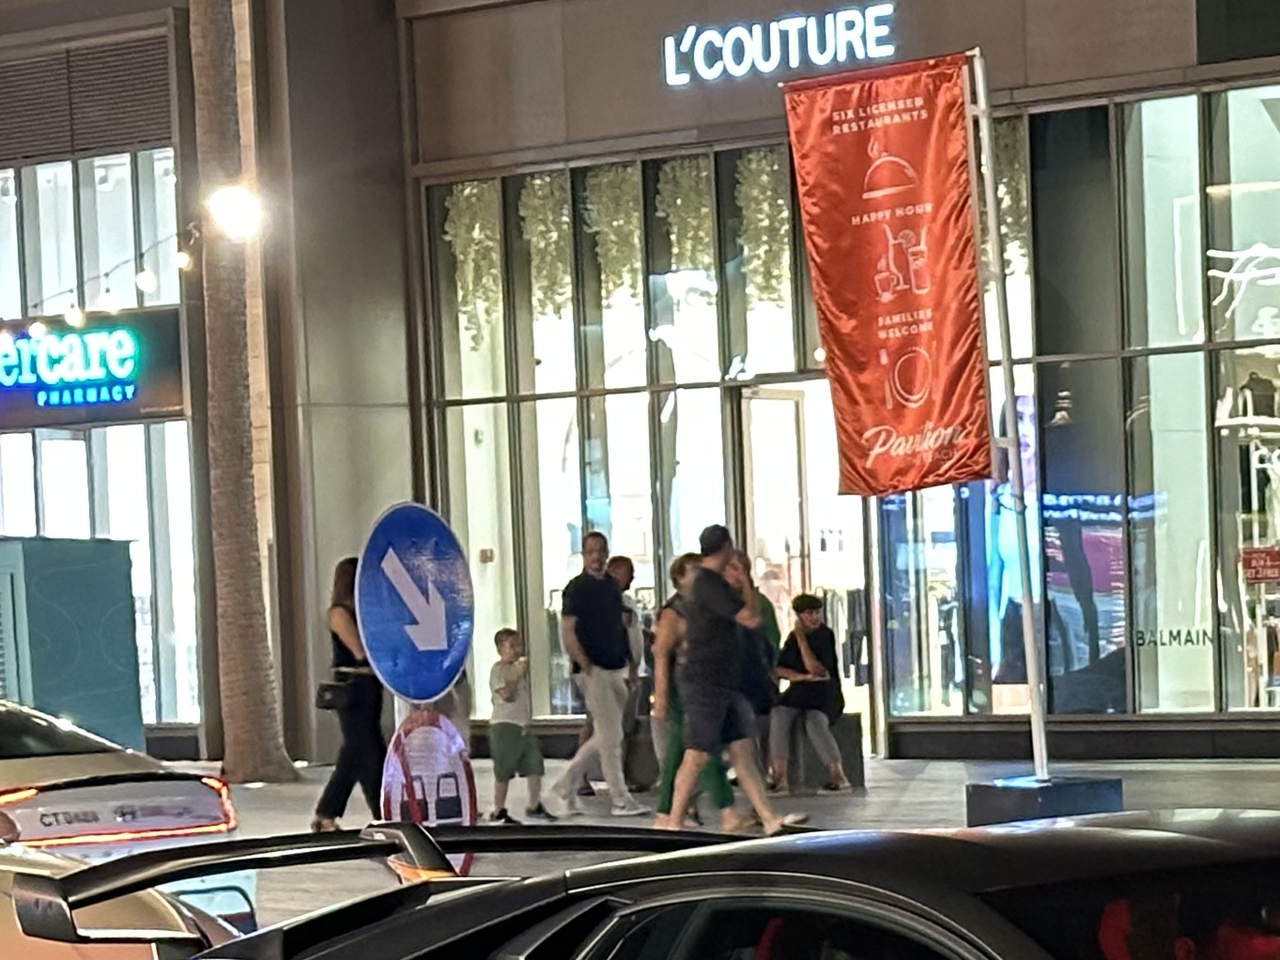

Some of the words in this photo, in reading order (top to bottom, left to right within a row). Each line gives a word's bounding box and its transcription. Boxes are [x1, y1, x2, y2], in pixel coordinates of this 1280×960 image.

[832, 109, 855, 121] SIX
[859, 97, 924, 117] LICENSED
[832, 110, 928, 135] RESTAURANTS
[851, 209, 892, 226] HAPPY
[37, 385, 135, 406] PHARMACY
[1136, 629, 1213, 646] BALMAIN
